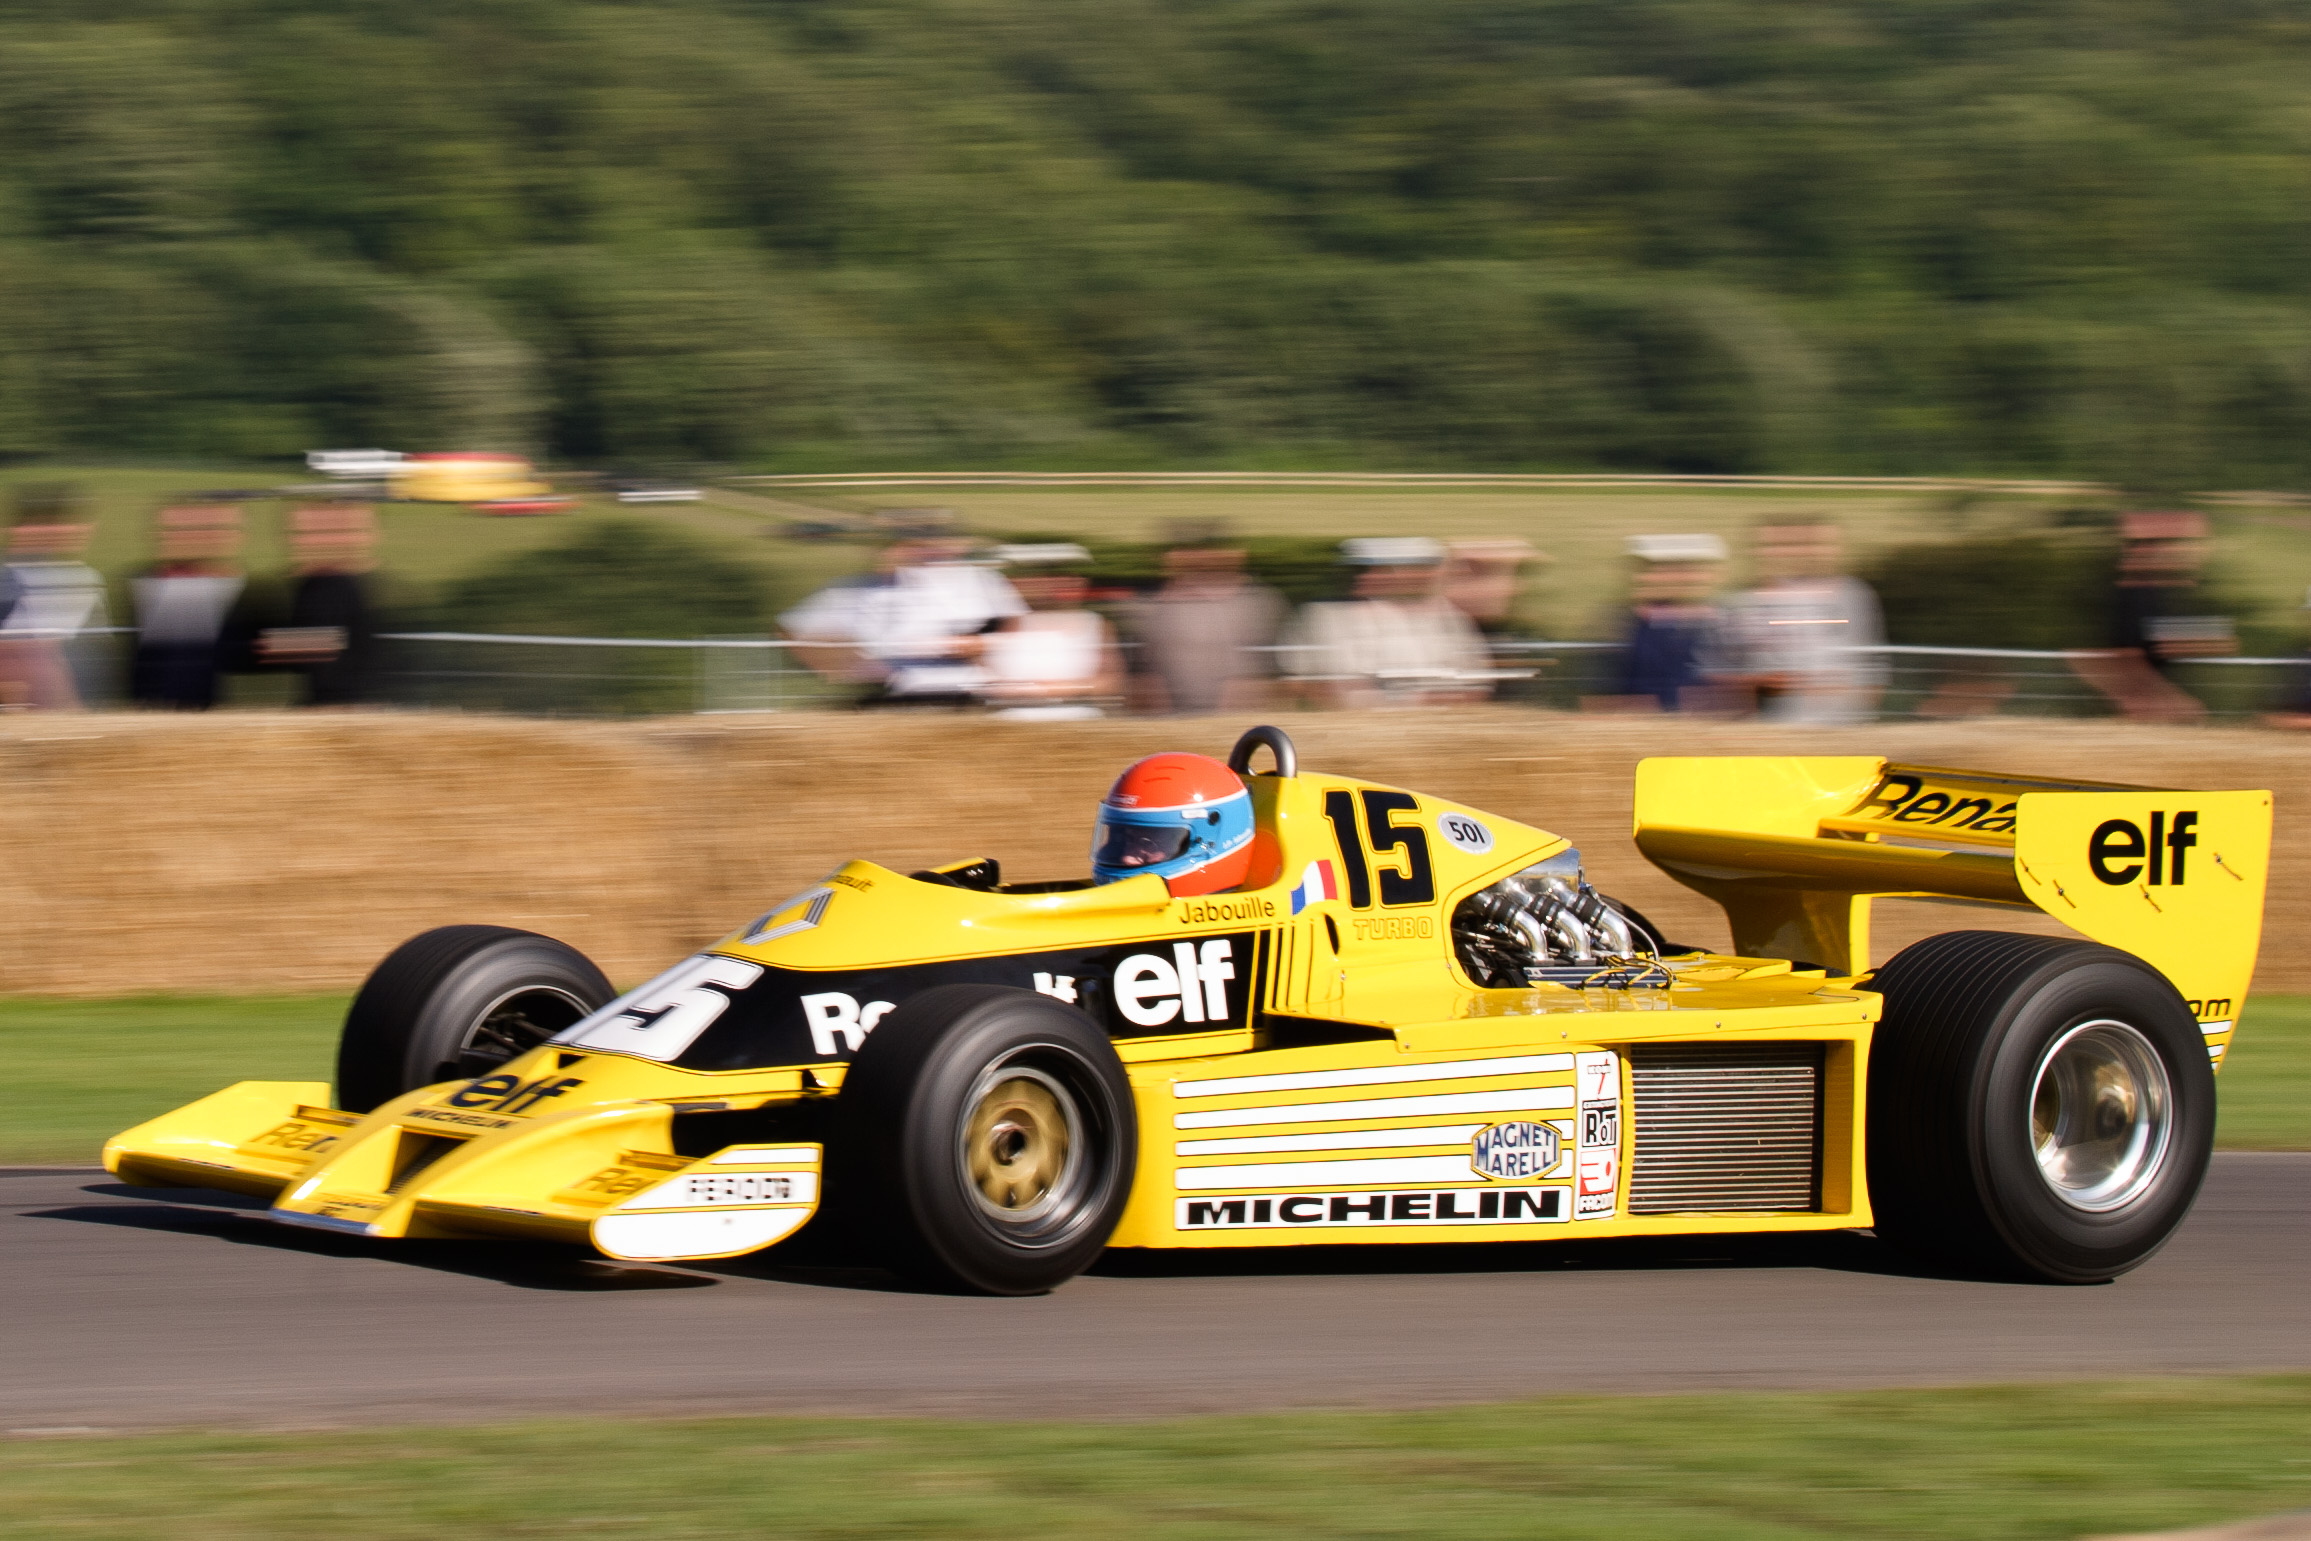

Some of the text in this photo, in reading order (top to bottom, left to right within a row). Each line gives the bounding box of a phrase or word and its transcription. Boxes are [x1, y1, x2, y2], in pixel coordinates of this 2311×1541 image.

[1325, 790, 1435, 908] 15
[1448, 820, 1486, 844] 501
[2088, 810, 2198, 886] elf
[1179, 897, 1275, 924] Jabouille
[1352, 917, 1433, 941] TURBO
[1114, 940, 1235, 1026] elf
[450, 1074, 585, 1113] elf
[1187, 1190, 1560, 1225] MICHELIN
